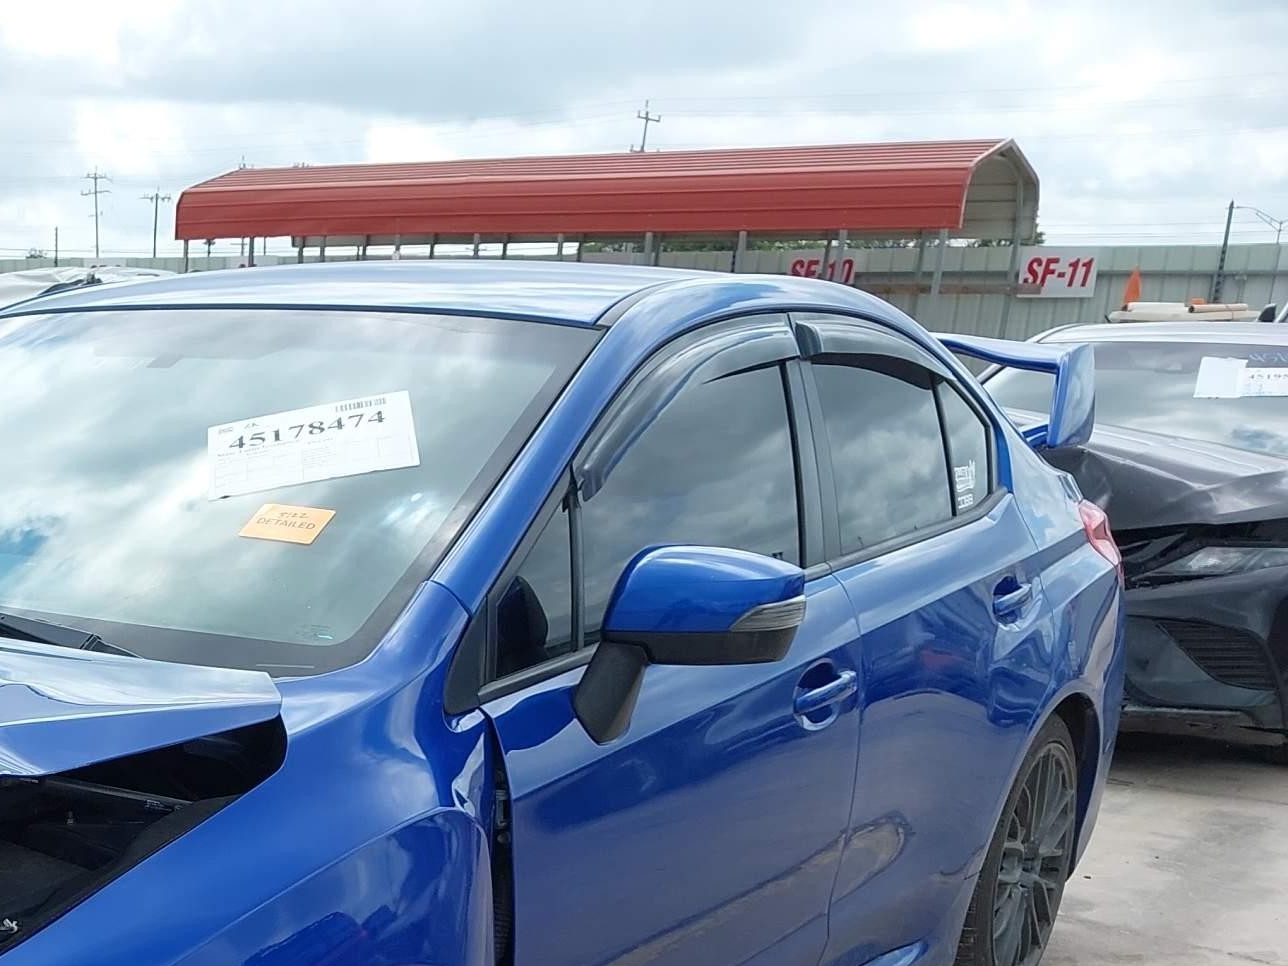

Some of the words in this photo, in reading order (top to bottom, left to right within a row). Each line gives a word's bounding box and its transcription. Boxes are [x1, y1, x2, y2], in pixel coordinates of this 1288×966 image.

[1023, 257, 1094, 287] SF-11
[229, 410, 386, 449] 45178474
[256, 517, 316, 530] DETAILED
